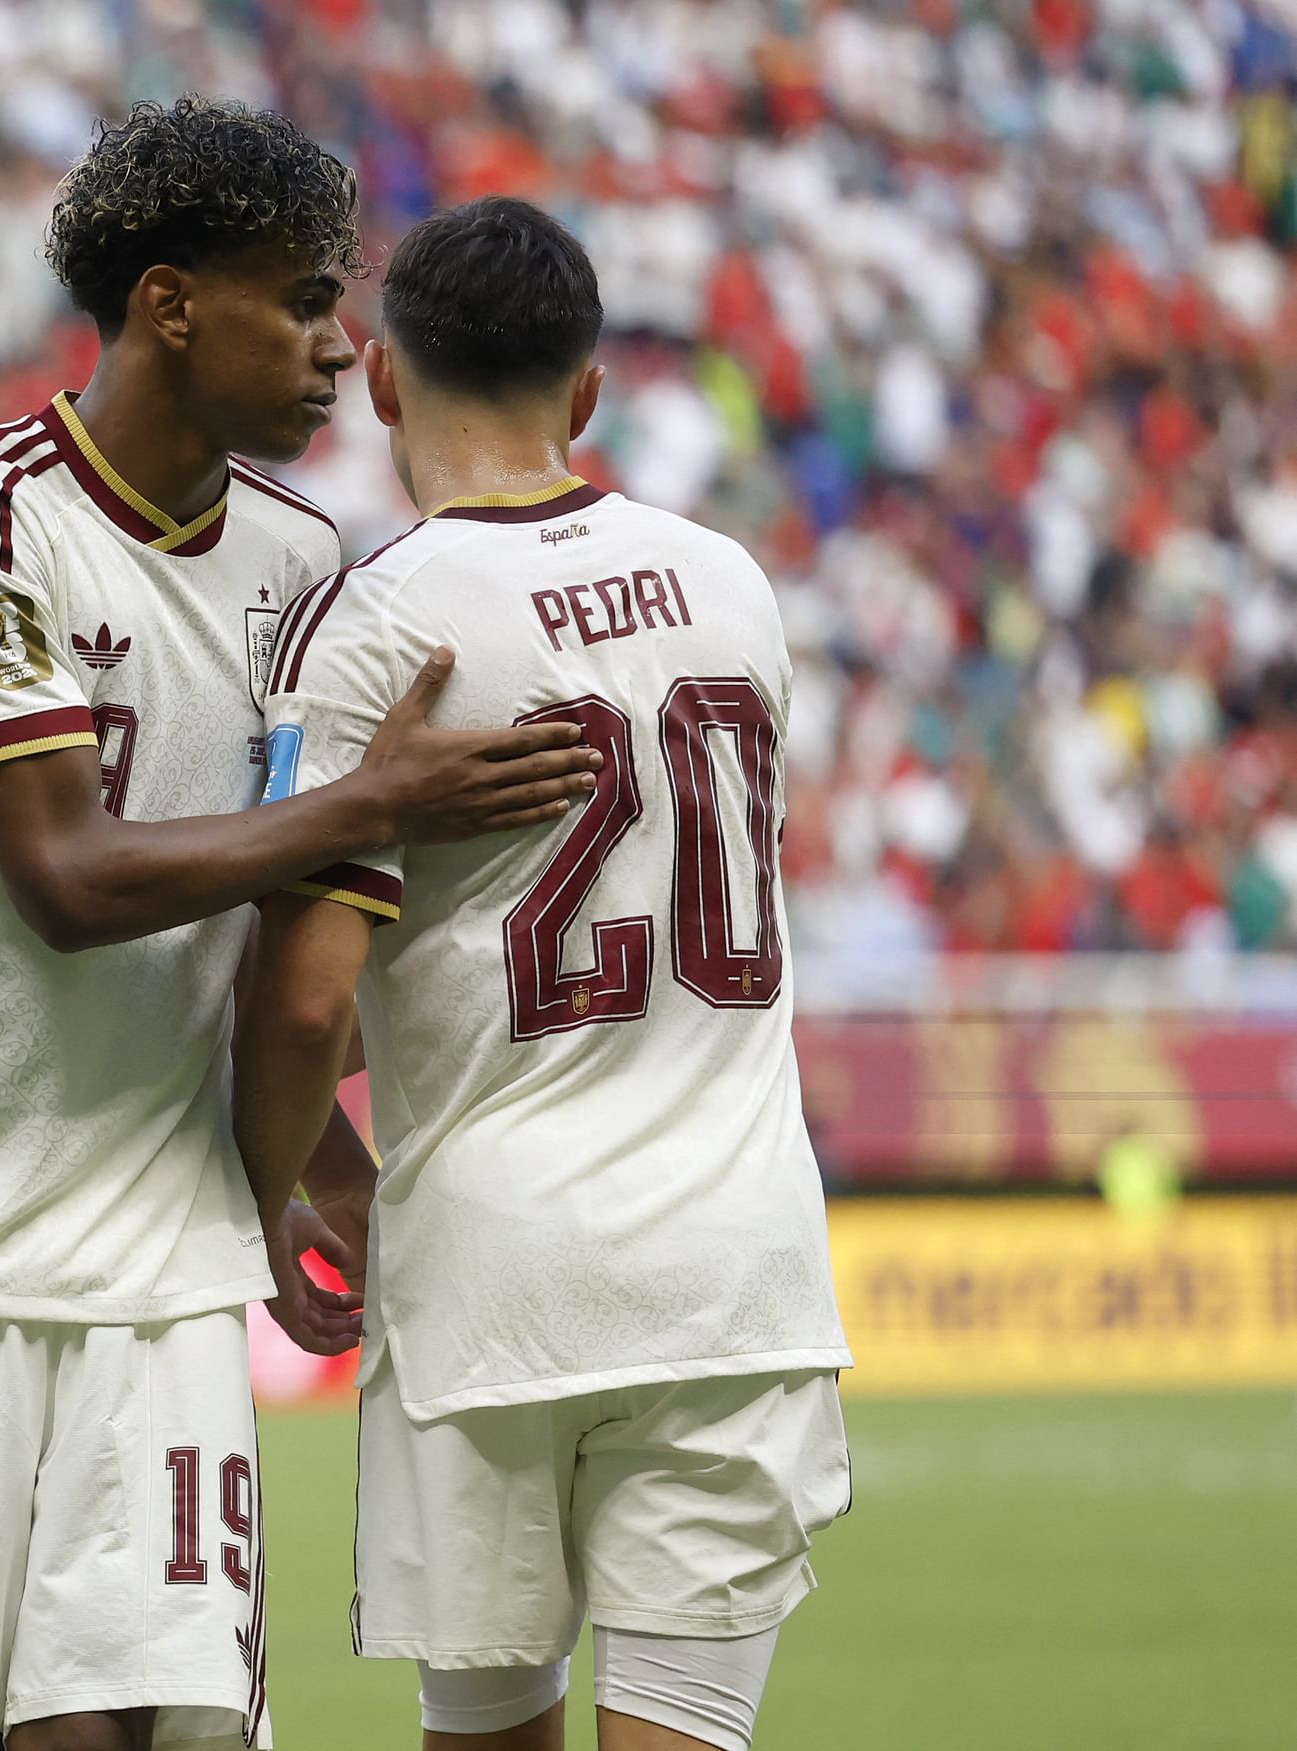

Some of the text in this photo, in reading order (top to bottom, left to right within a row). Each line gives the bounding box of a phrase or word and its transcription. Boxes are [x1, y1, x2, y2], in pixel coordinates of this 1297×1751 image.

[539, 523, 590, 547] España
[530, 568, 693, 652] PEDRI
[502, 676, 783, 1043] 20
[165, 1446, 252, 1597] 19
